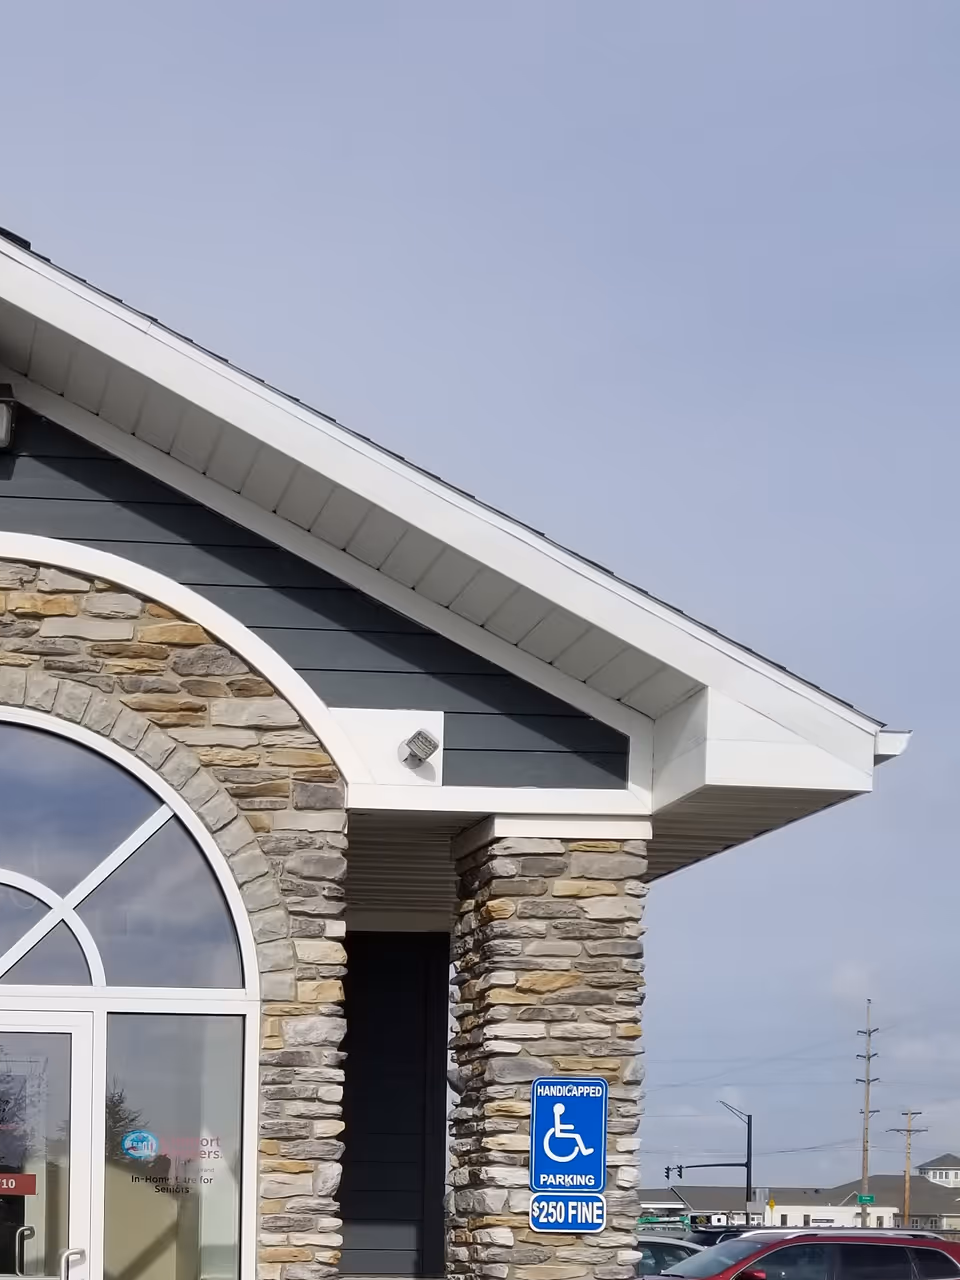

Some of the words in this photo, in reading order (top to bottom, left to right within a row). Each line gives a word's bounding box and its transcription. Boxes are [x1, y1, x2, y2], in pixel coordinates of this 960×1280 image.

[538, 1085, 602, 1097] HANDICAPPED
[200, 1176, 213, 1184] for
[540, 1174, 595, 1186] PARKING
[532, 1201, 565, 1223] $250
[568, 1202, 603, 1224] FINE
